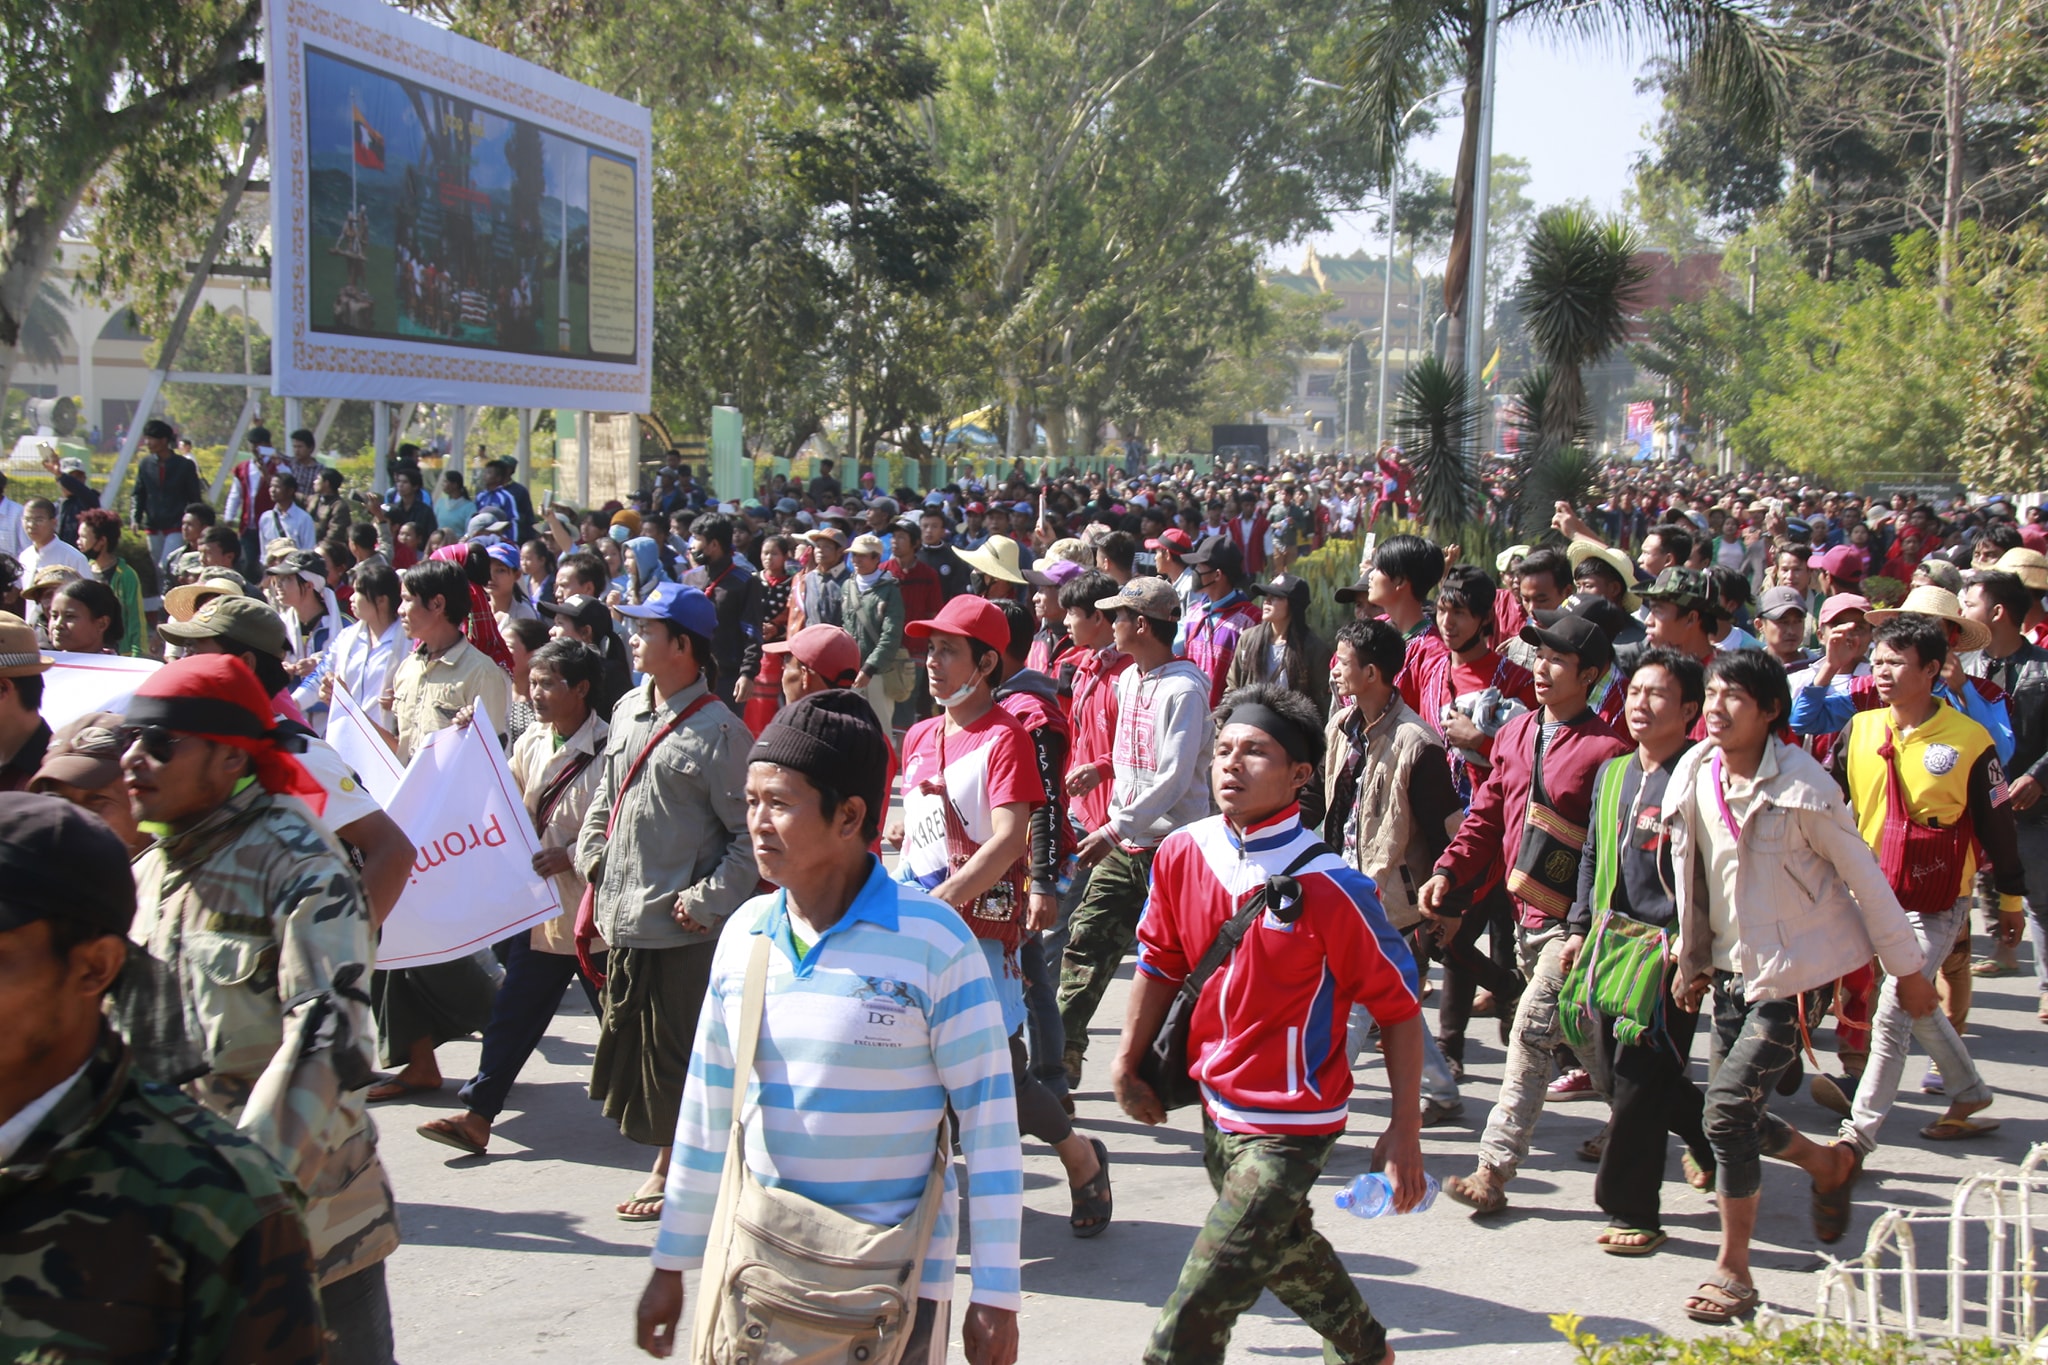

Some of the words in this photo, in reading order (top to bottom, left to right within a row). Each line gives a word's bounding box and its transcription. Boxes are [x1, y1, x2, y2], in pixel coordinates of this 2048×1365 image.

[1038, 744, 1049, 772] FILA
[1048, 839, 1057, 866] FILA
[867, 1011, 896, 1027] DG
